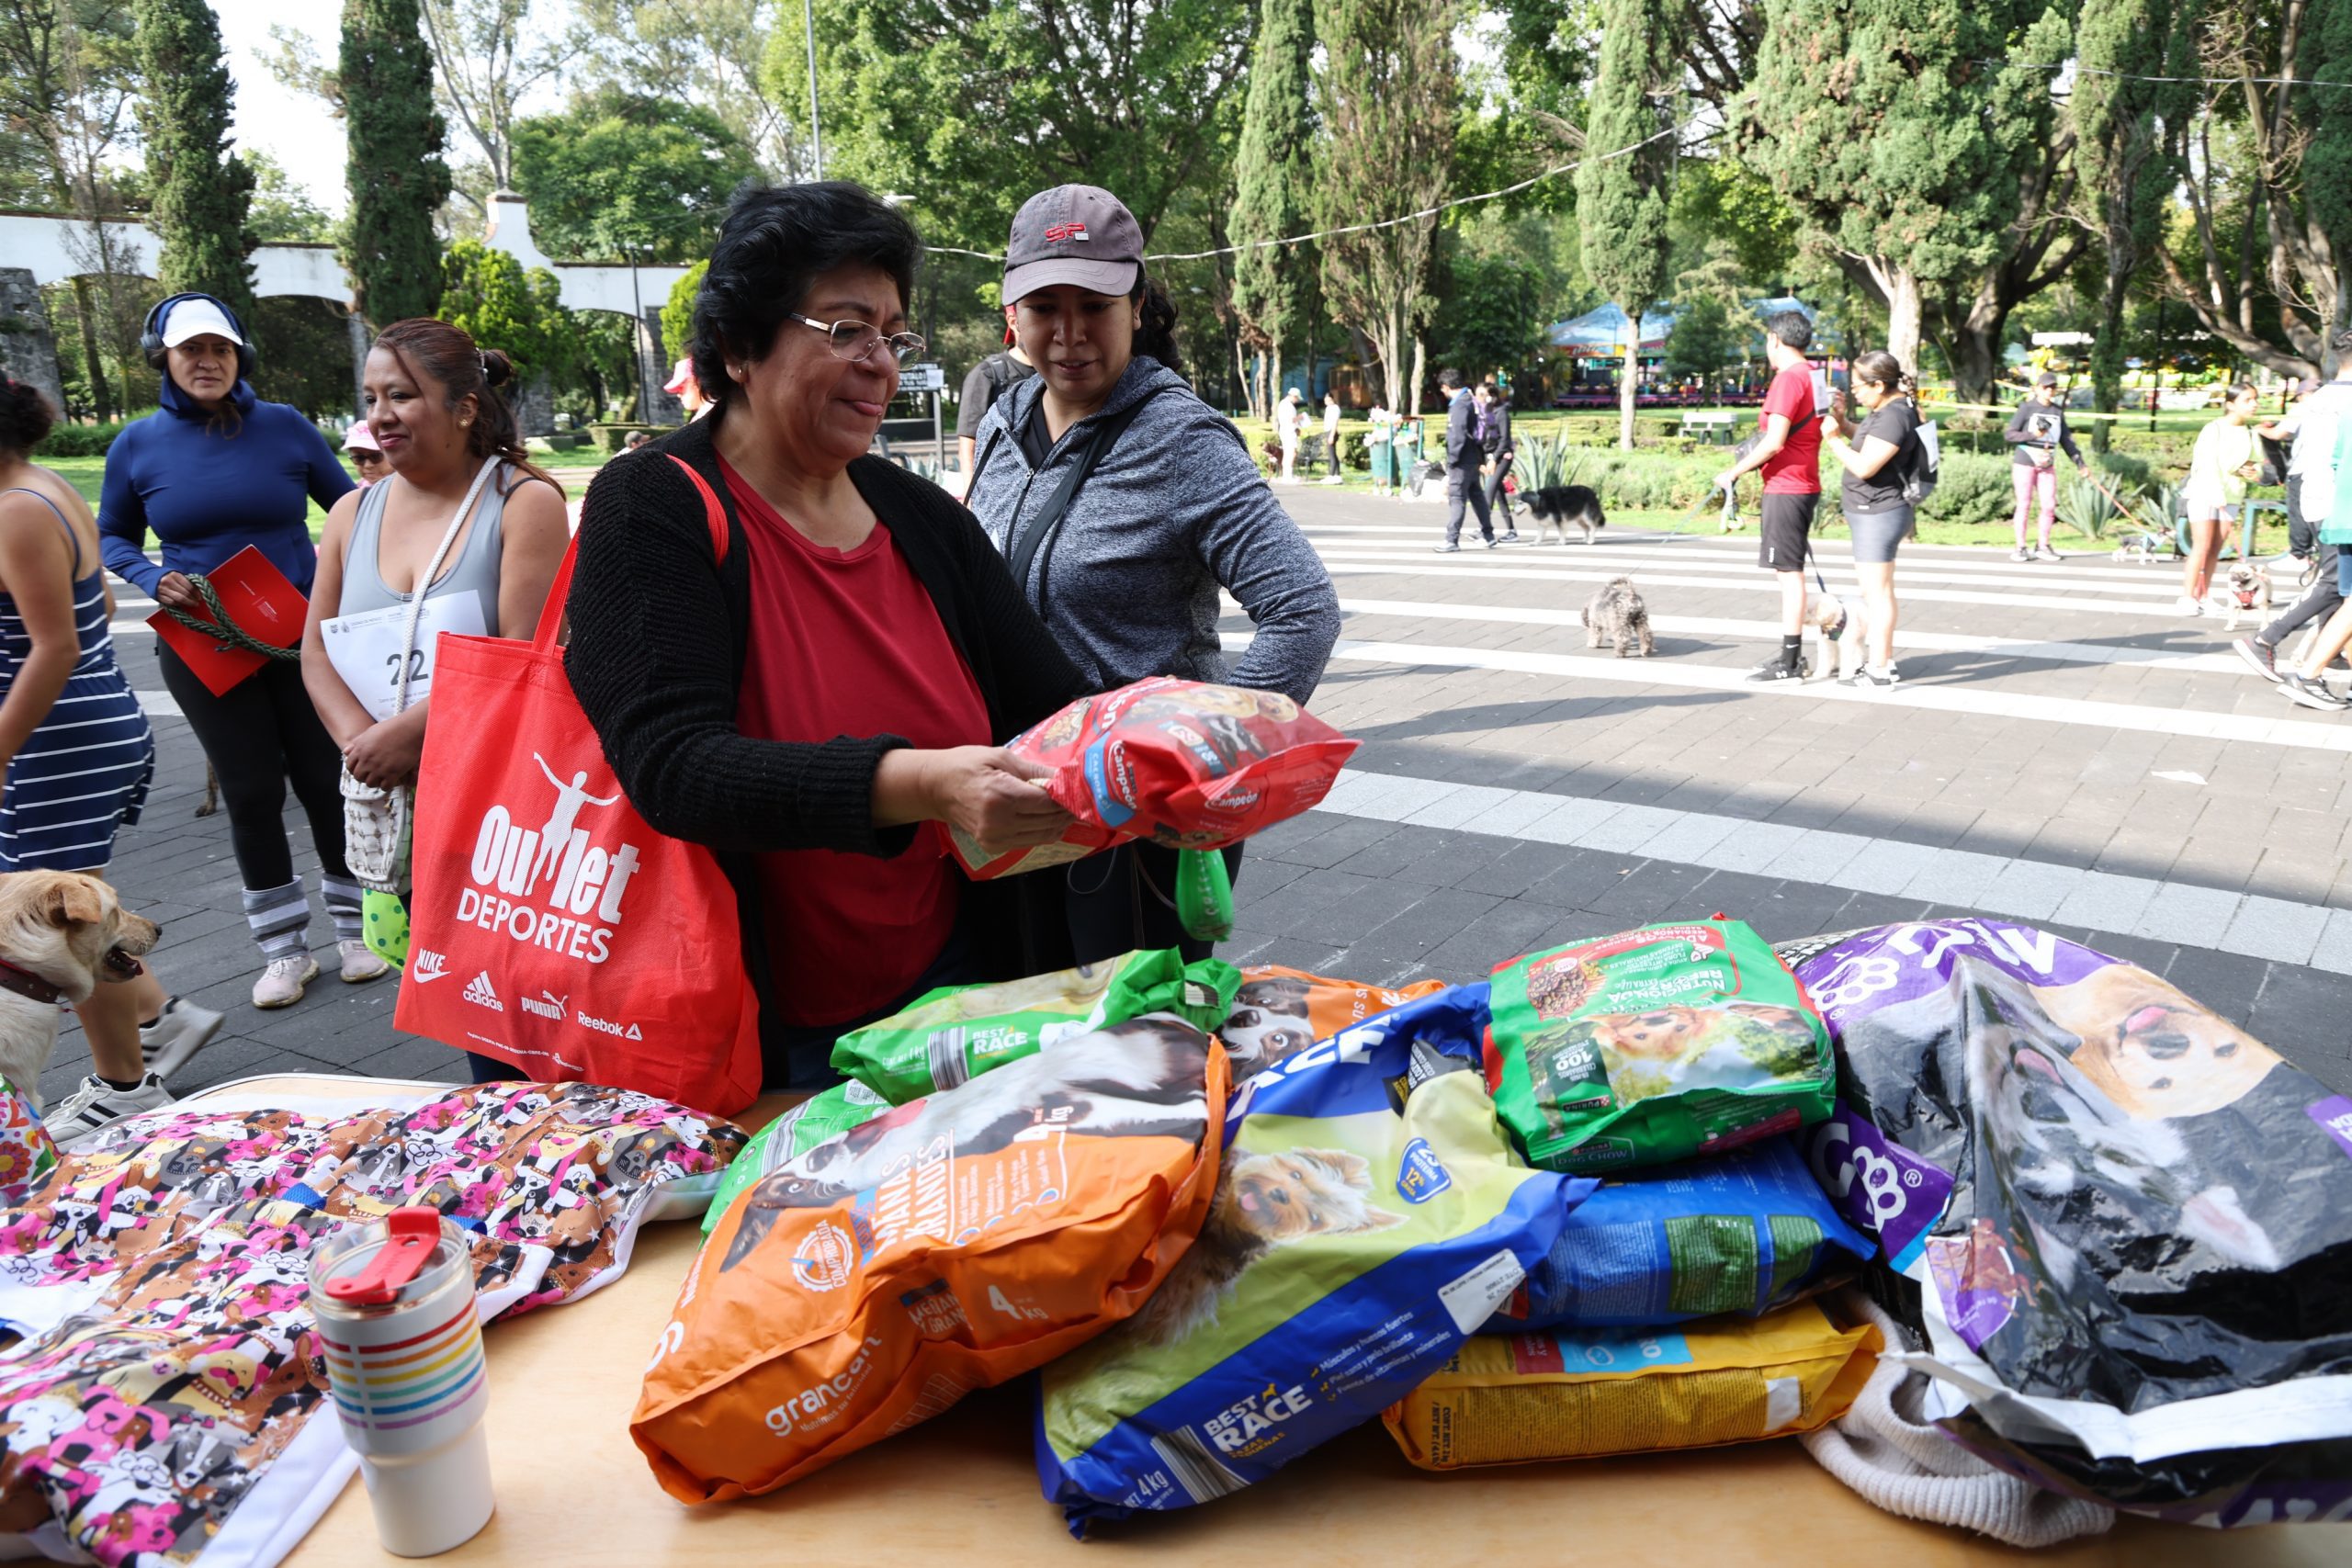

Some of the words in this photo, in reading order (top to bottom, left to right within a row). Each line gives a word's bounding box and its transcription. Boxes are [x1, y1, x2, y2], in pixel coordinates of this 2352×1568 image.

[1113, 741, 1138, 810] Campeón
[456, 887, 615, 964] DEPORTES
[417, 948, 447, 974] NIKE
[462, 989, 503, 1012] adidas
[521, 997, 561, 1021] PUMA
[578, 1010, 624, 1038] Reebok
[972, 1027, 1006, 1040] BEST
[973, 1032, 1029, 1055] RACE
[1555, 1051, 1593, 1071] 100
[1012, 1122, 1068, 1143] 4
[1044, 1105, 1075, 1122] kg
[815, 1218, 847, 1289] COMPROBADA
[988, 1285, 1022, 1321] 4
[1021, 1304, 1049, 1323] kg
[1385, 1311, 1414, 1332] fuertes
[1415, 1331, 1452, 1356] minerales
[764, 1337, 882, 1438] grancan
[799, 1408, 839, 1435] Nutrimos
[1203, 1394, 1260, 1438] BEST
[1213, 1383, 1314, 1453] RACE
[1136, 1475, 1151, 1498] 4
[1148, 1470, 1170, 1492] kg
